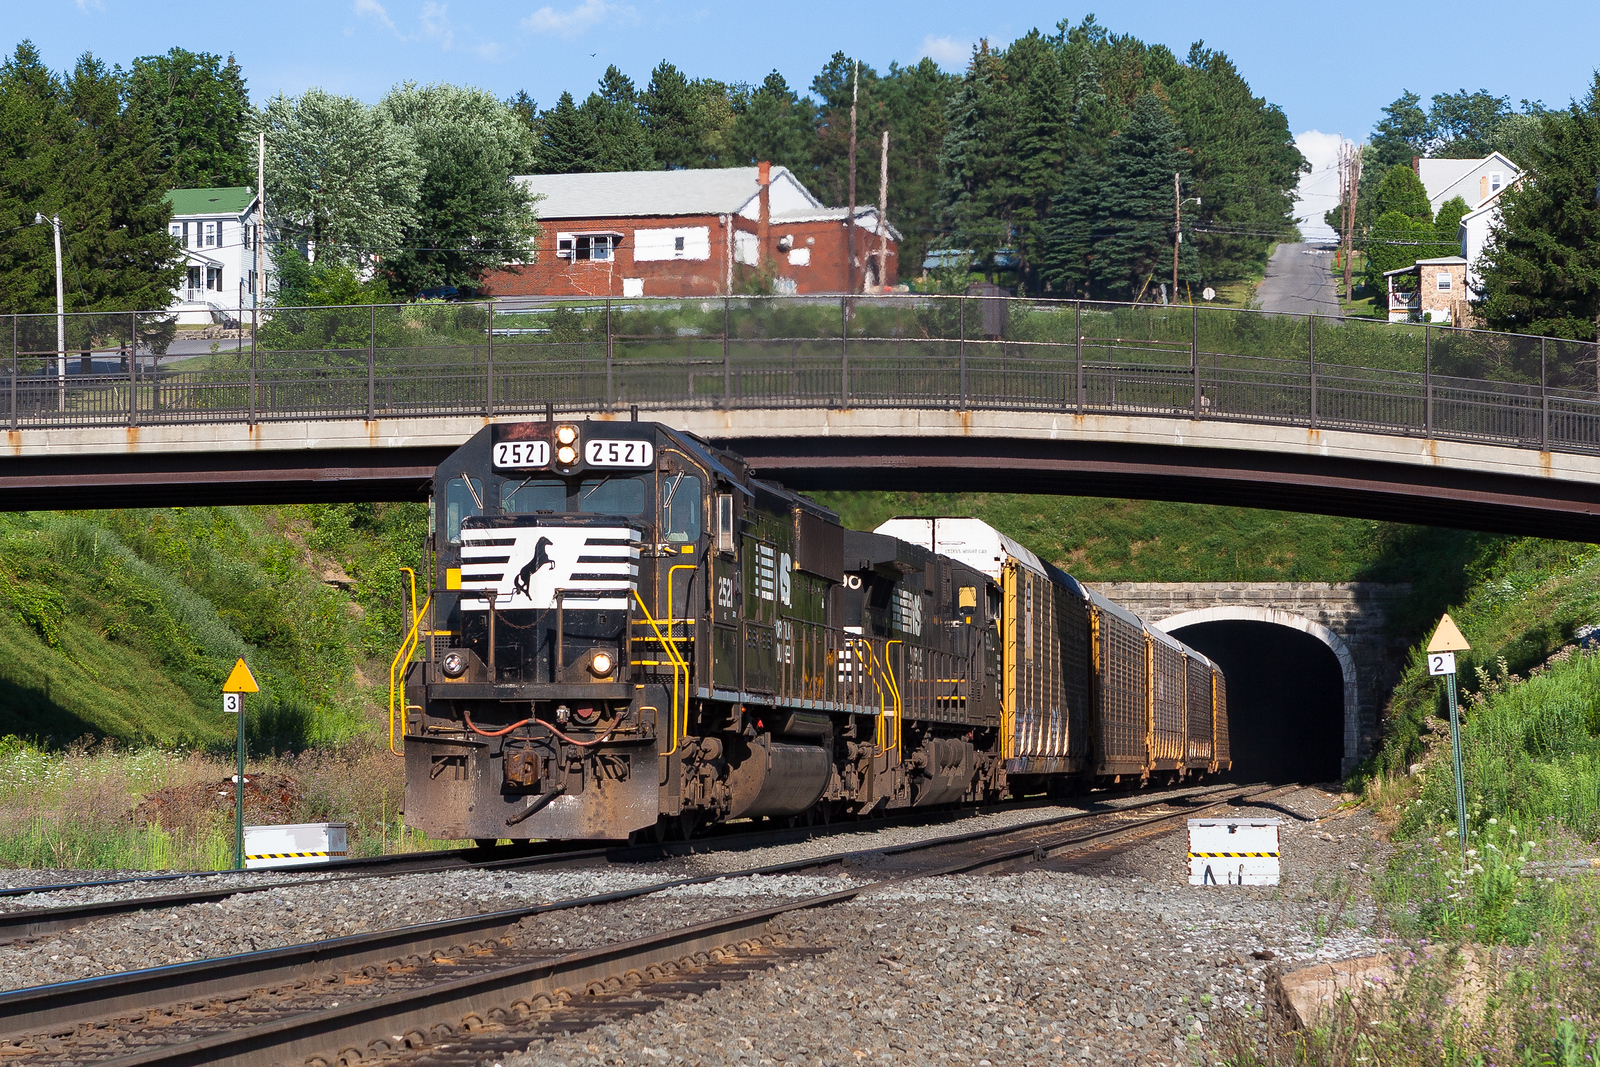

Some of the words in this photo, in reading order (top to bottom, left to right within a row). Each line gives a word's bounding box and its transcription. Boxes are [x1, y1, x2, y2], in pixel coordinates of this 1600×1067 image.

[499, 443, 544, 464] 2521
[592, 442, 646, 463] 2521
[718, 576, 733, 608] 2521
[1433, 656, 1444, 672] 2
[227, 696, 236, 710] 3
